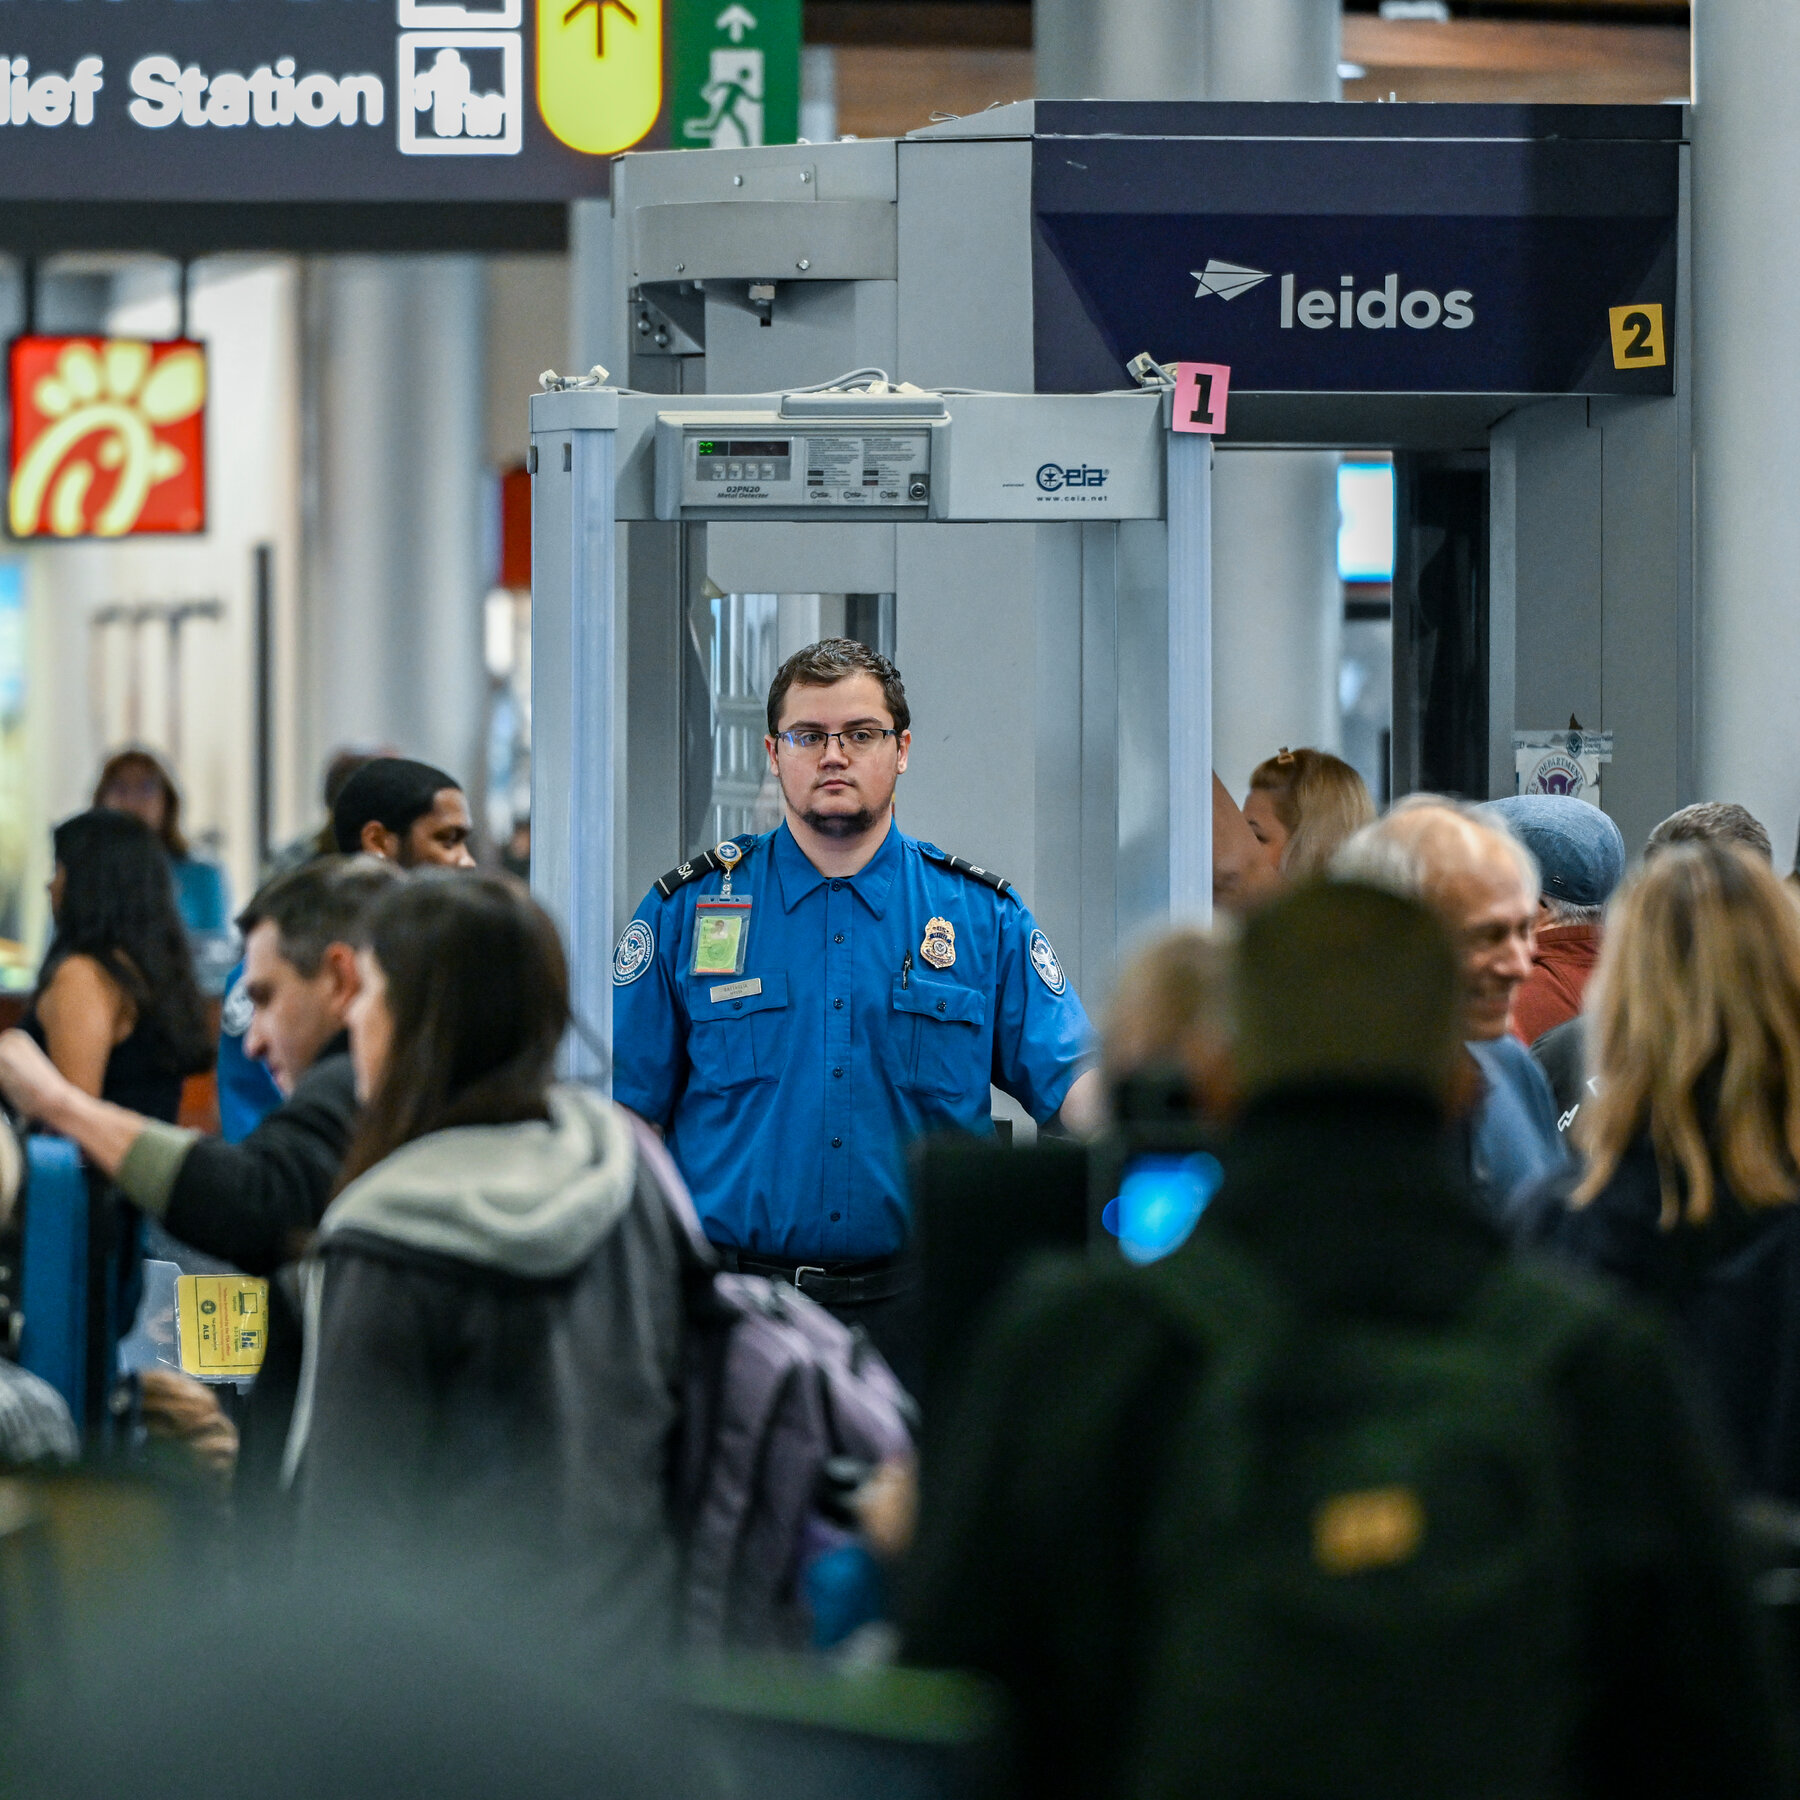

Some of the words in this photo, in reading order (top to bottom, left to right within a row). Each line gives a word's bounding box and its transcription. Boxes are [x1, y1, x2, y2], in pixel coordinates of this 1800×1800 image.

[128, 55, 385, 128] Station
[1280, 273, 1475, 329] leidos
[1621, 311, 1655, 358] 2
[1189, 373, 1214, 424] 1
[726, 485, 761, 493] 02PN20
[1538, 756, 1584, 785] DEPARTMENT
